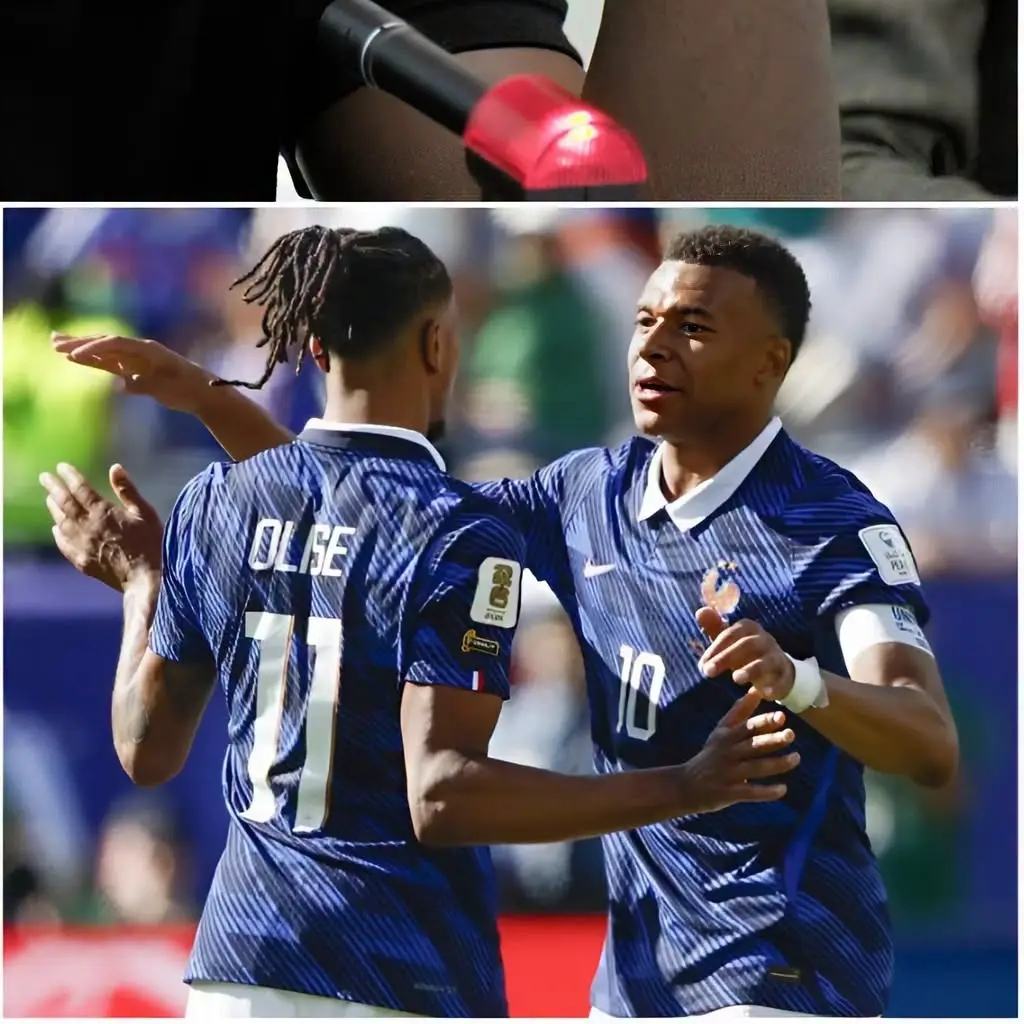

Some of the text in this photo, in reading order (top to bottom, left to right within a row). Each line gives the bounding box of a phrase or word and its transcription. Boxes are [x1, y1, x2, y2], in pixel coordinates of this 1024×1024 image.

[248, 518, 356, 577] OLISE
[238, 610, 343, 833] 11
[616, 643, 666, 741] 10
